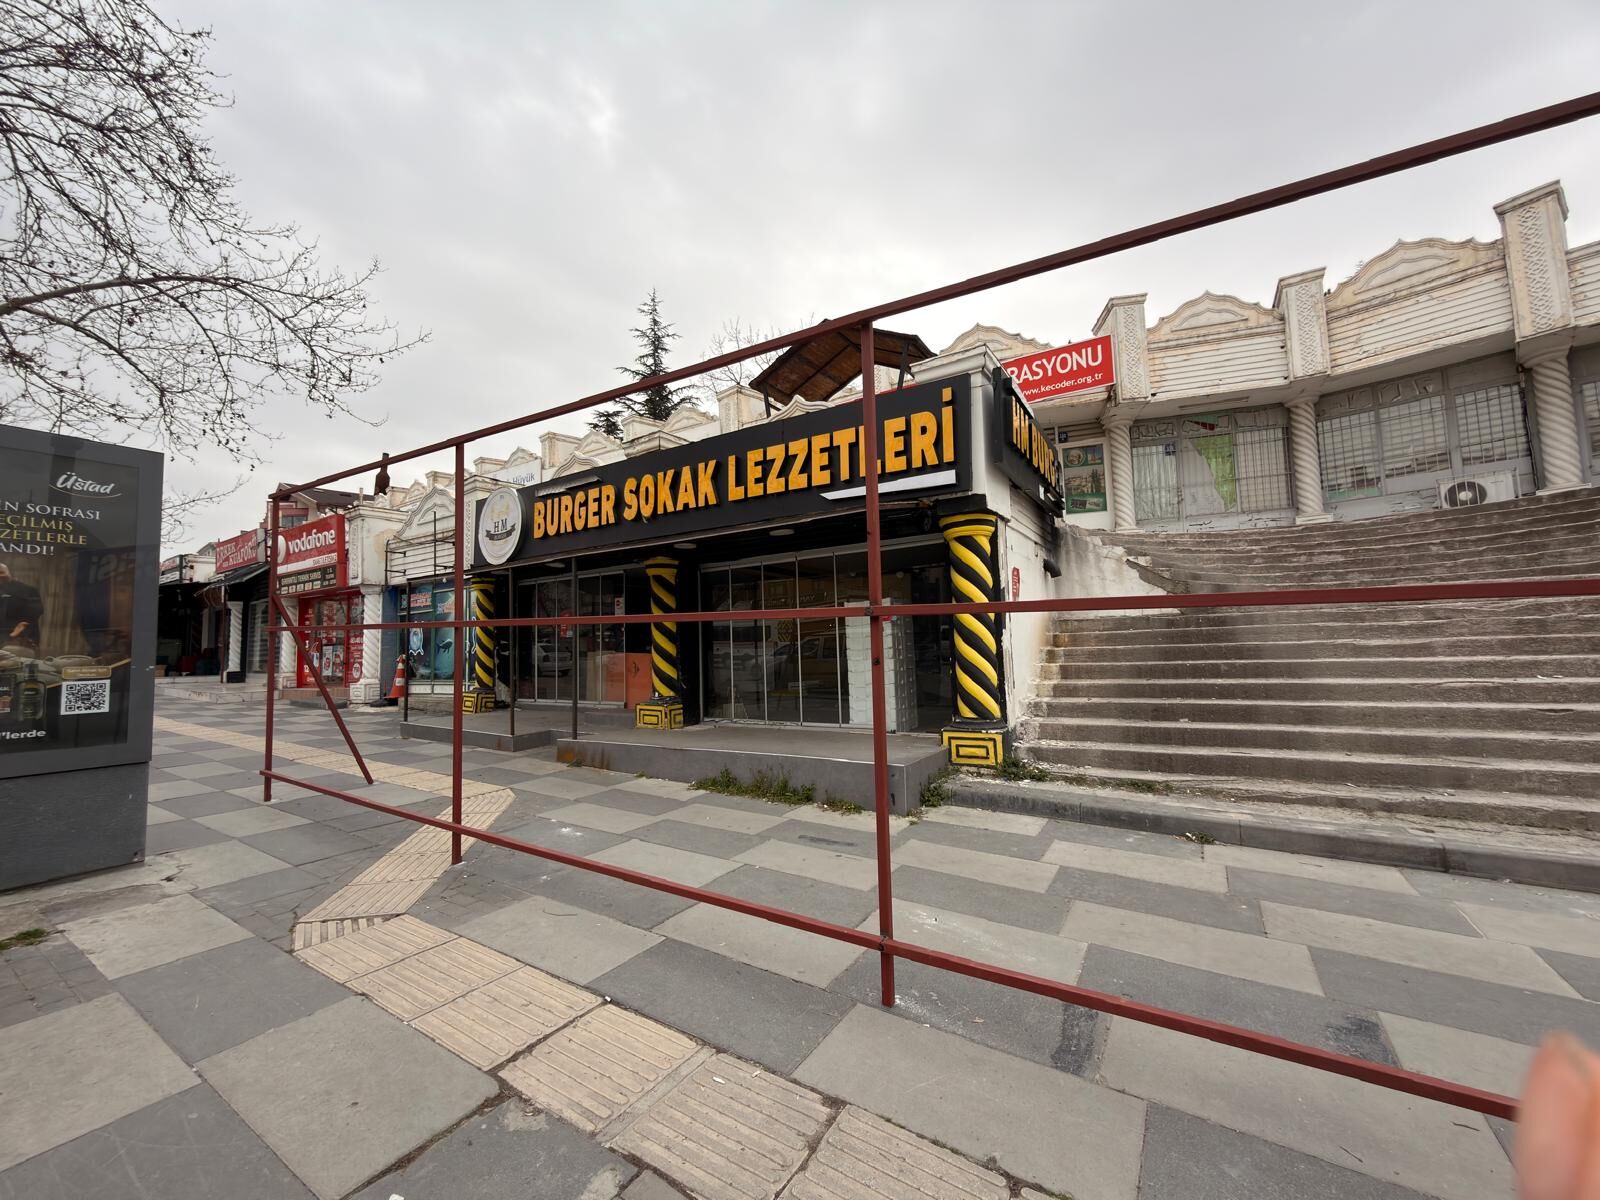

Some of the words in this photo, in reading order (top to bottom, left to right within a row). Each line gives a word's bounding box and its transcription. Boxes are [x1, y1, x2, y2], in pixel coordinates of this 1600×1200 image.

[1011, 395, 1030, 460] HM
[56, 472, 115, 494] Üstad
[533, 484, 616, 539] BURGER
[623, 459, 718, 521] SOKAK
[26, 503, 101, 520] SOFRASI
[0, 529, 88, 545] ZETLERLE
[288, 529, 336, 554] vodafone
[0, 543, 55, 556] ANDI!
